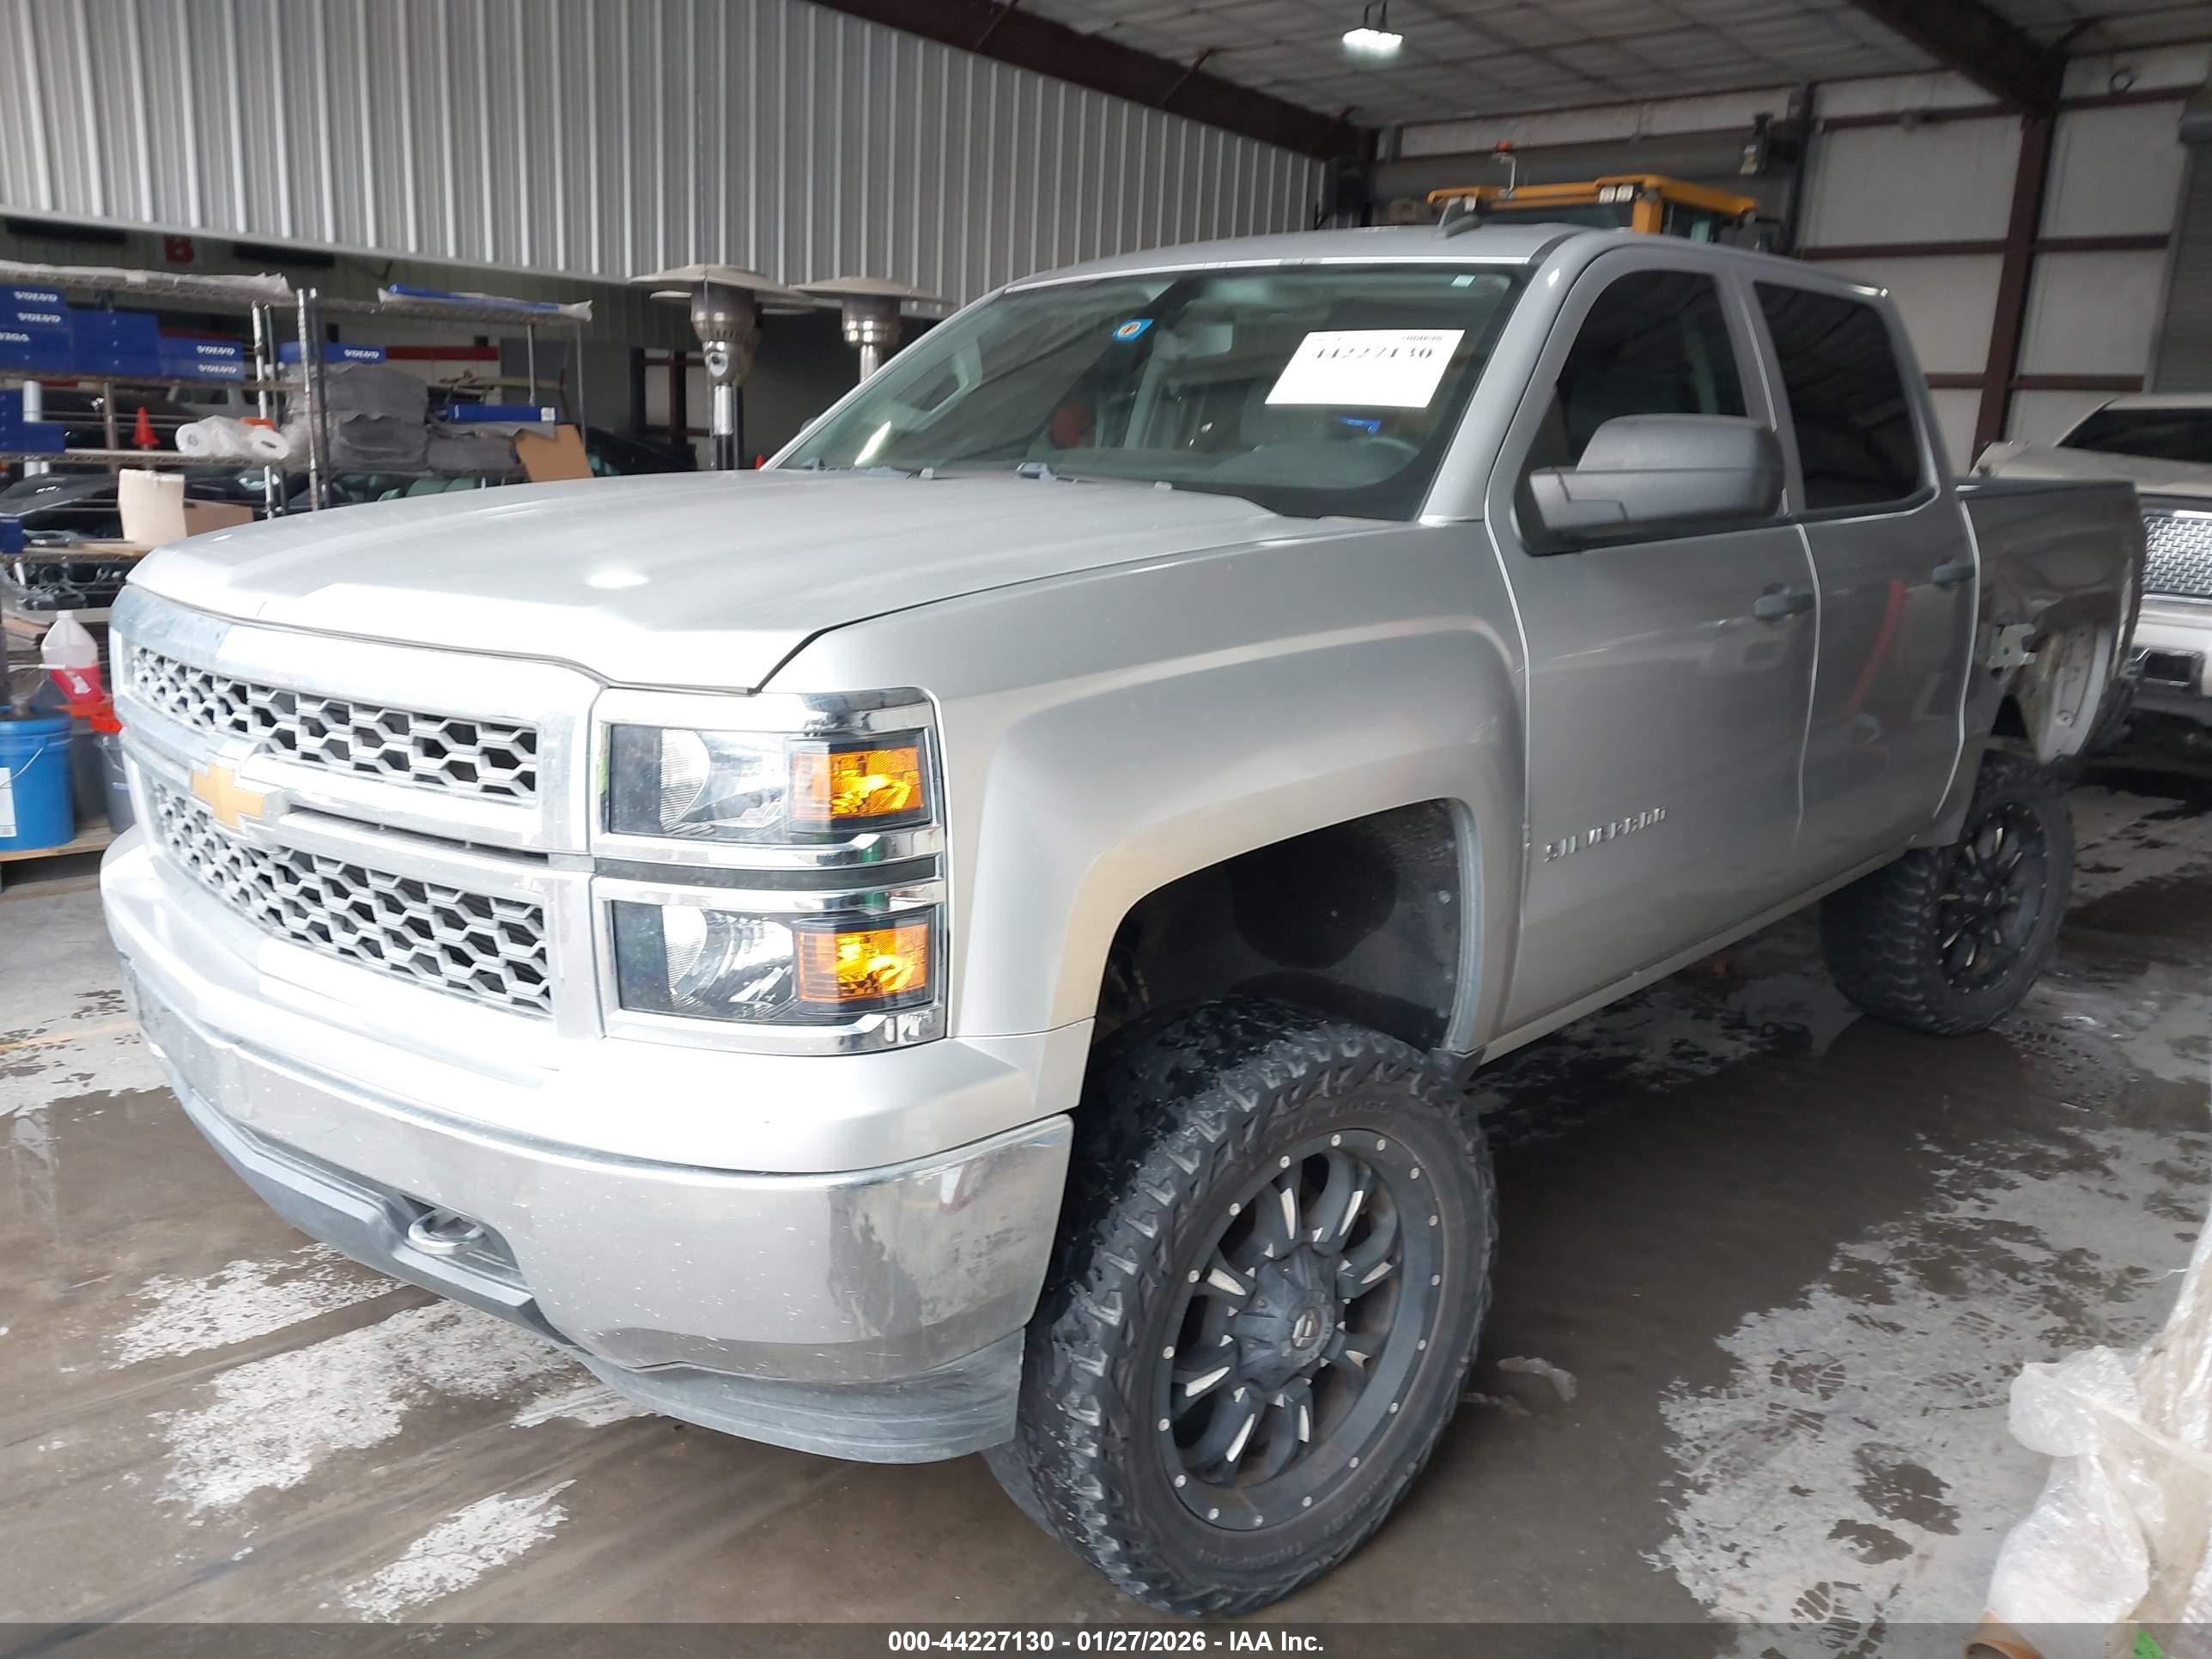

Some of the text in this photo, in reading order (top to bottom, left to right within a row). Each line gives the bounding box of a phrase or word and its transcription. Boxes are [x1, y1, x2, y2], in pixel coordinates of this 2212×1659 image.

[14, 291, 58, 302] VOLVO
[17, 312, 61, 323] VOLVO
[197, 345, 235, 356] VOLVO
[343, 348, 380, 359] VOLVO
[198, 363, 237, 374] VOLVO
